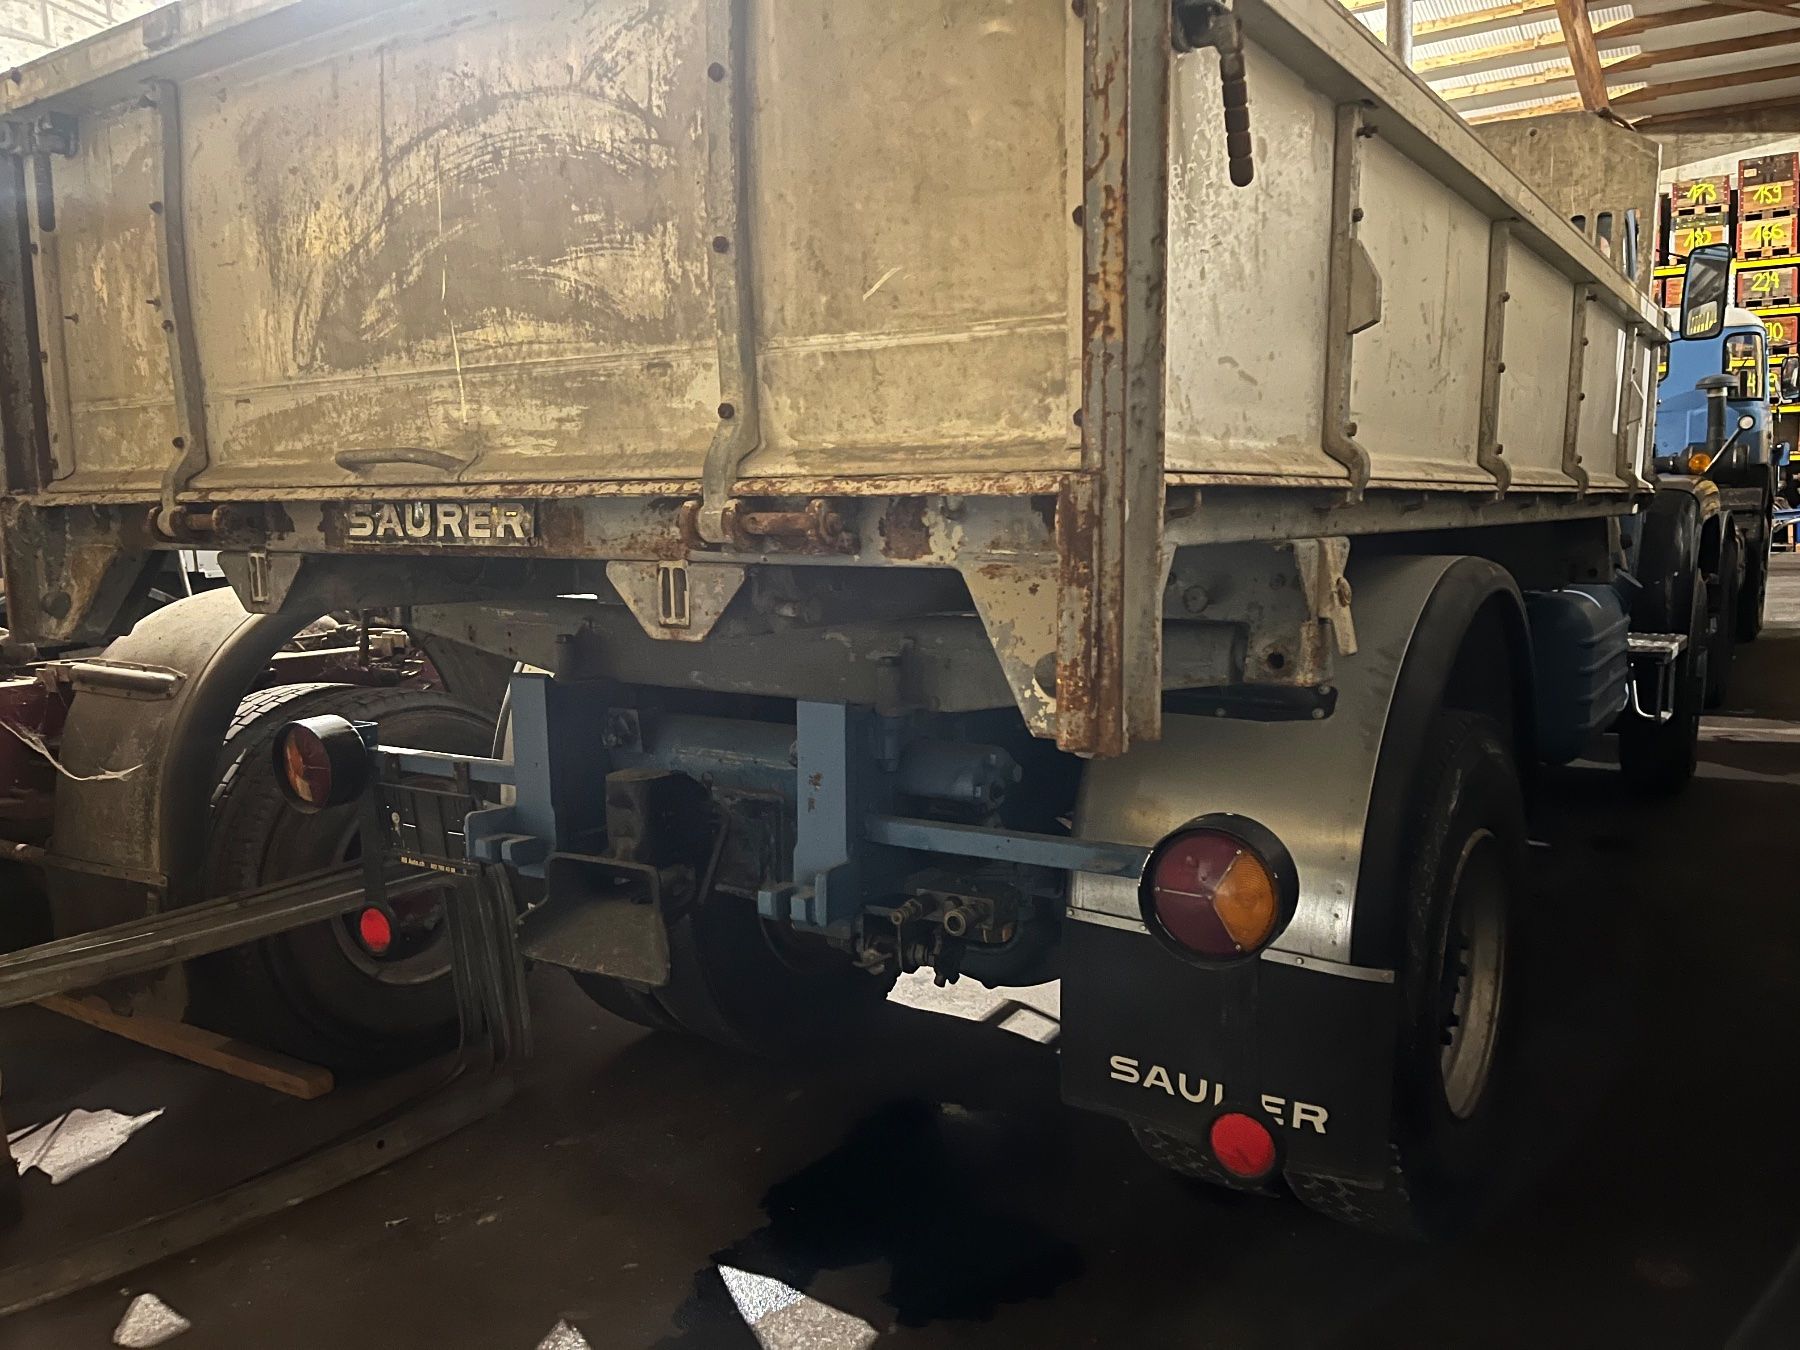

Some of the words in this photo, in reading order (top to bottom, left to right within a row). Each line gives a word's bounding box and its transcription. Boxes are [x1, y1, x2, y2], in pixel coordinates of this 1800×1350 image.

[1687, 184, 1717, 202] 173
[1753, 185, 1782, 204] 159
[1750, 223, 1784, 241] 166
[350, 502, 526, 539] SAURER
